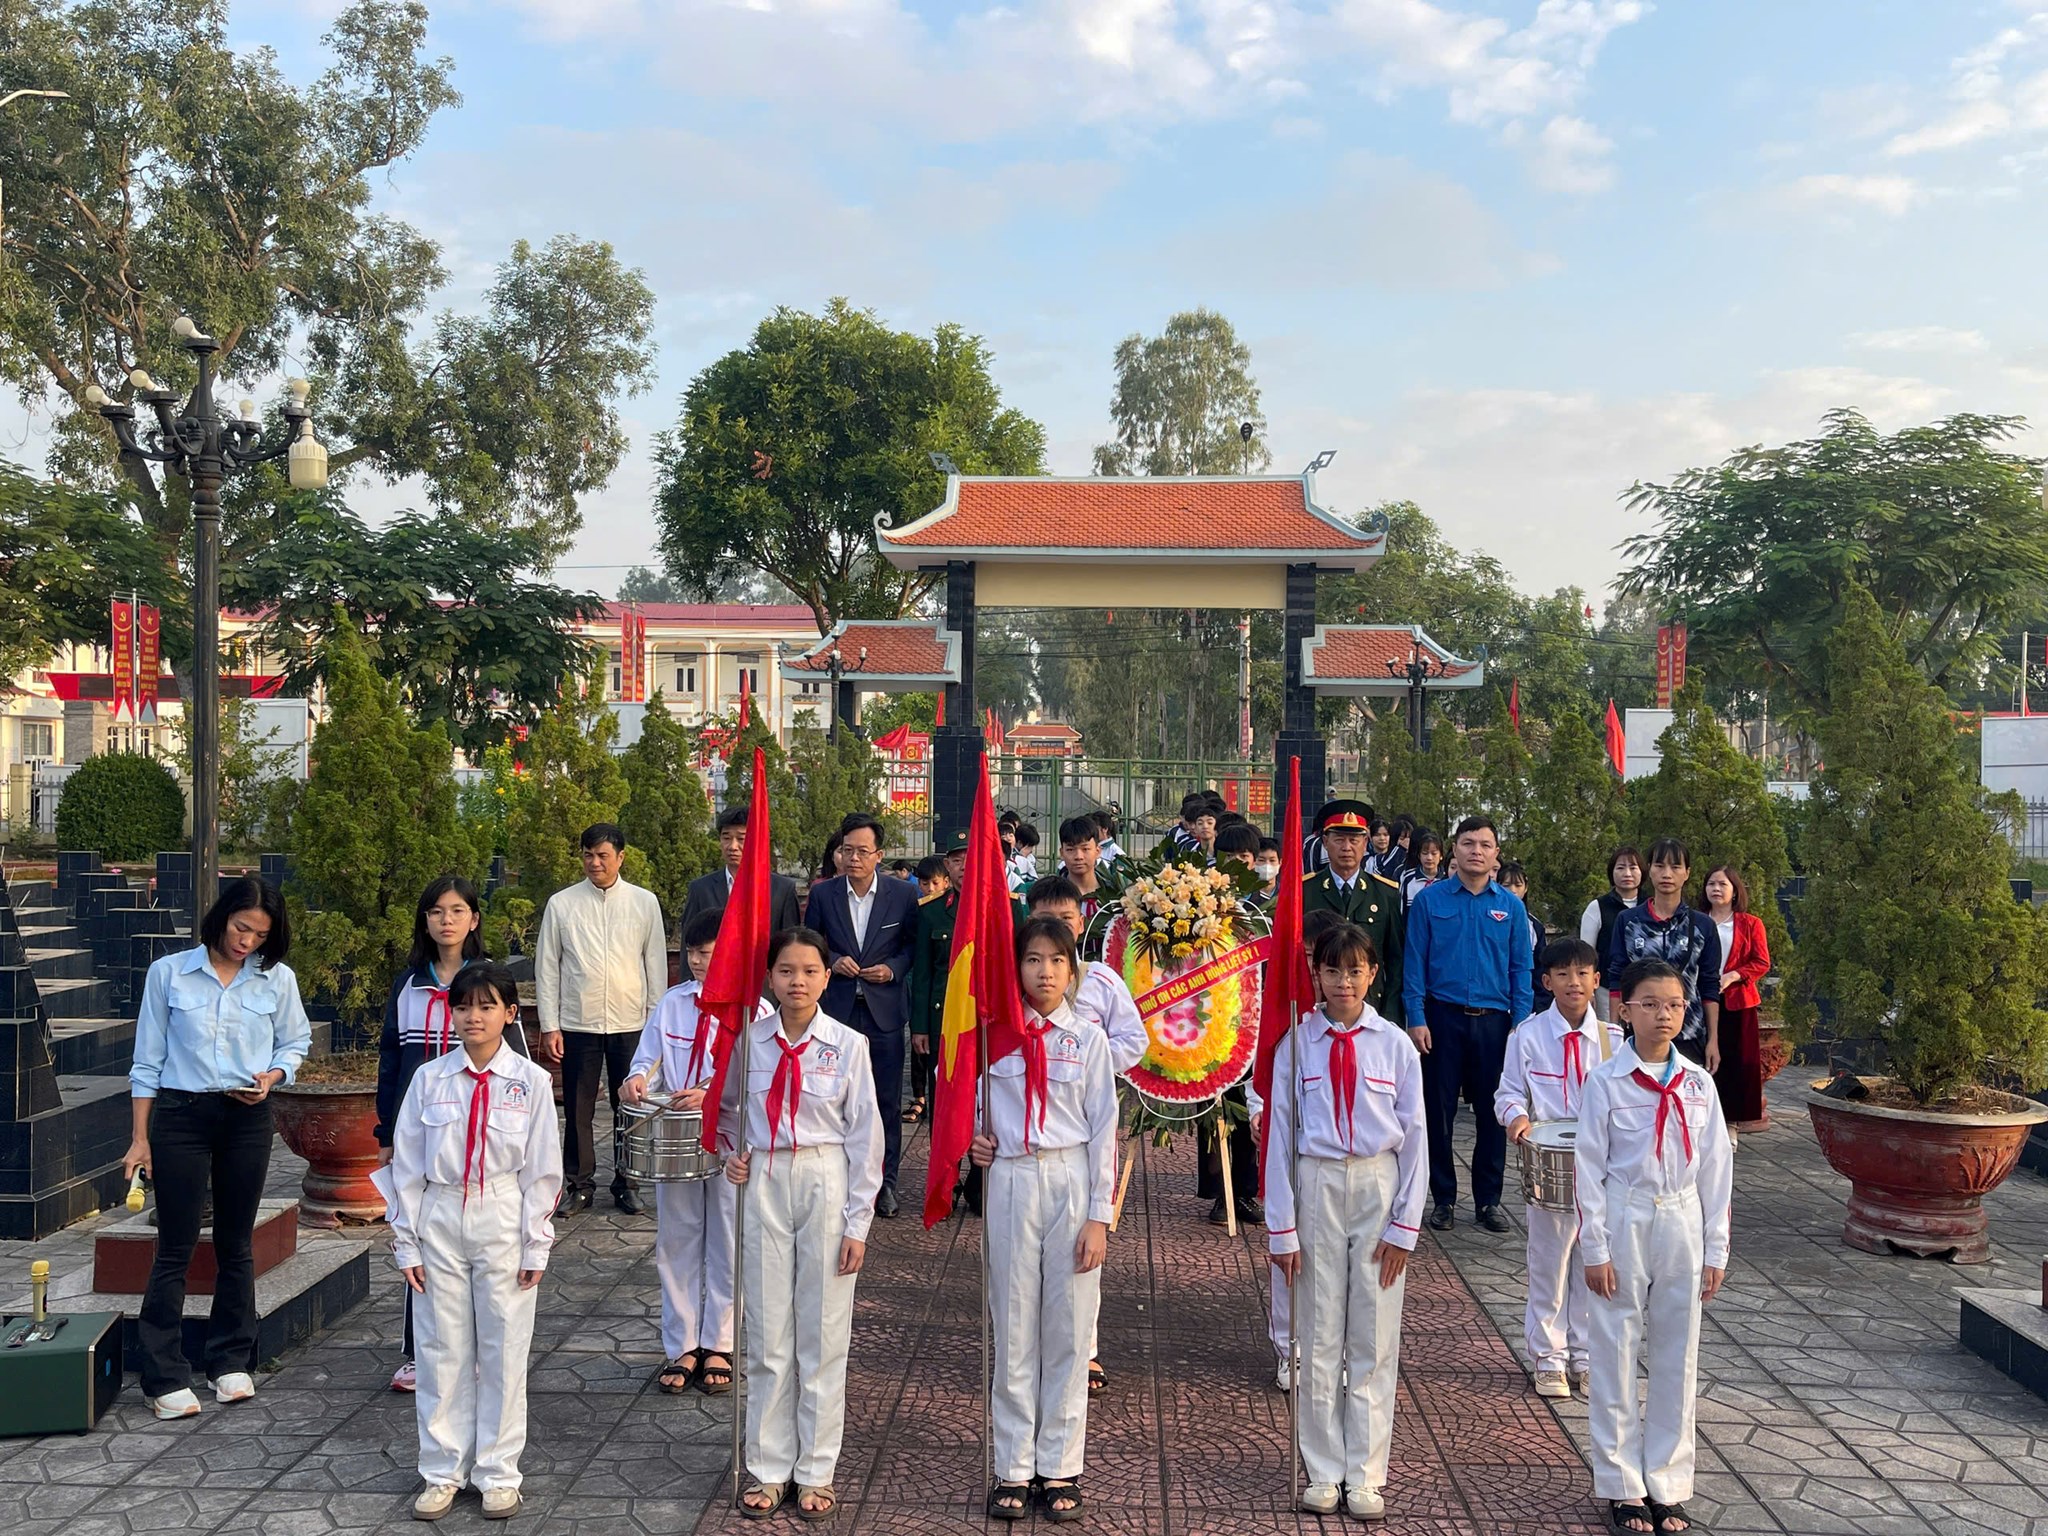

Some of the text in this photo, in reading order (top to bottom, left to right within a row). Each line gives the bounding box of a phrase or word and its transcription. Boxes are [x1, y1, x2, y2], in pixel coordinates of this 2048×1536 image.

[1170, 982, 1188, 998] CÁC
[1187, 972, 1207, 990] ANH
[1204, 964, 1227, 981] HÙNG
